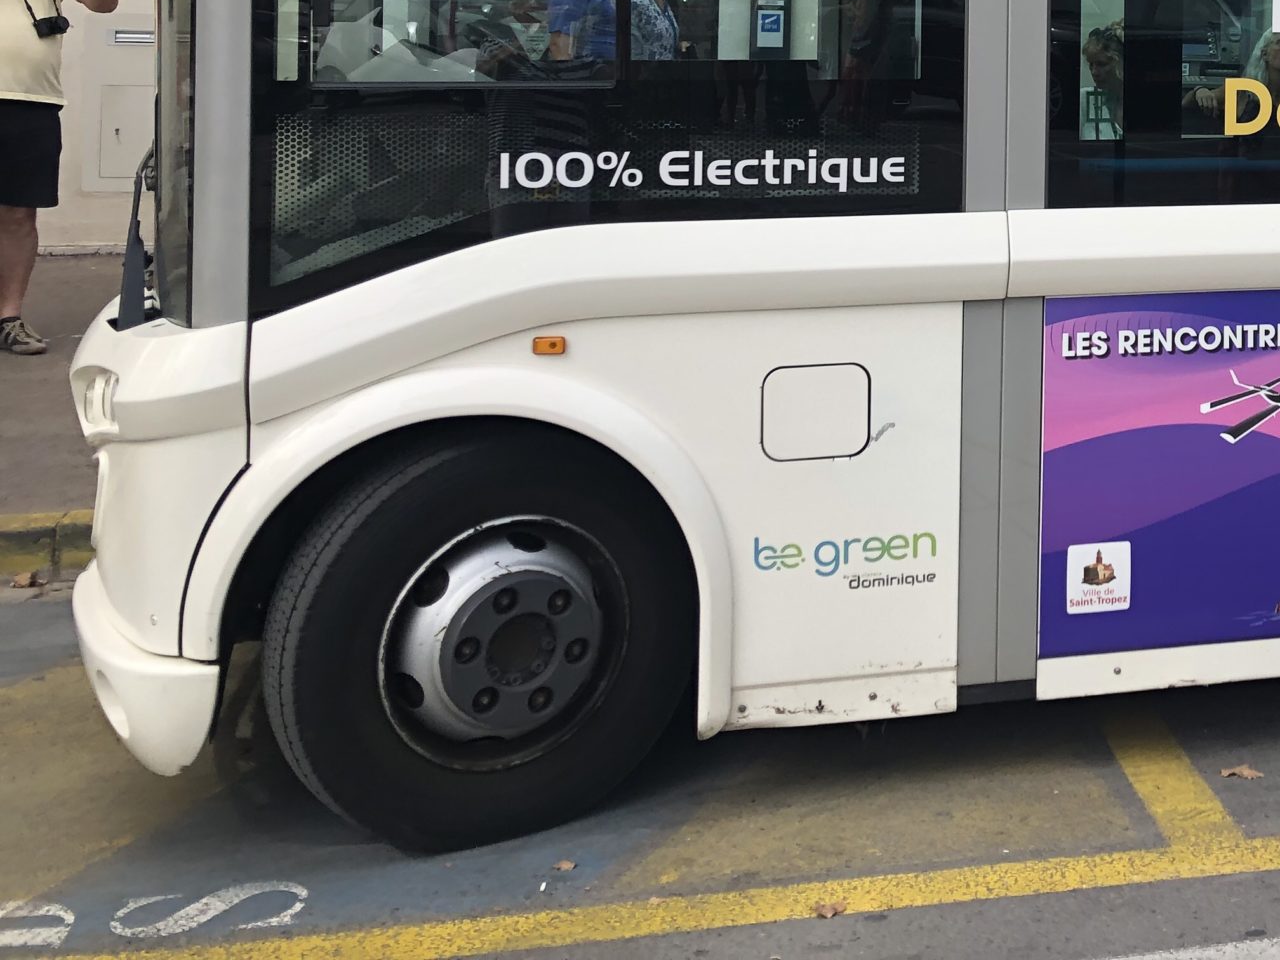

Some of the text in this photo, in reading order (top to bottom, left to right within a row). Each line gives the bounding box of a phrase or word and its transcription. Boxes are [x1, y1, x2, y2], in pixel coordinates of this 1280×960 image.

[499, 148, 905, 193] 100% Electrique
[1061, 331, 1109, 358] LES
[753, 530, 938, 577] be green
[848, 572, 937, 590] dominique
[1069, 595, 1129, 608] Saint-Tropez
[1082, 587, 1115, 598] Ville de
